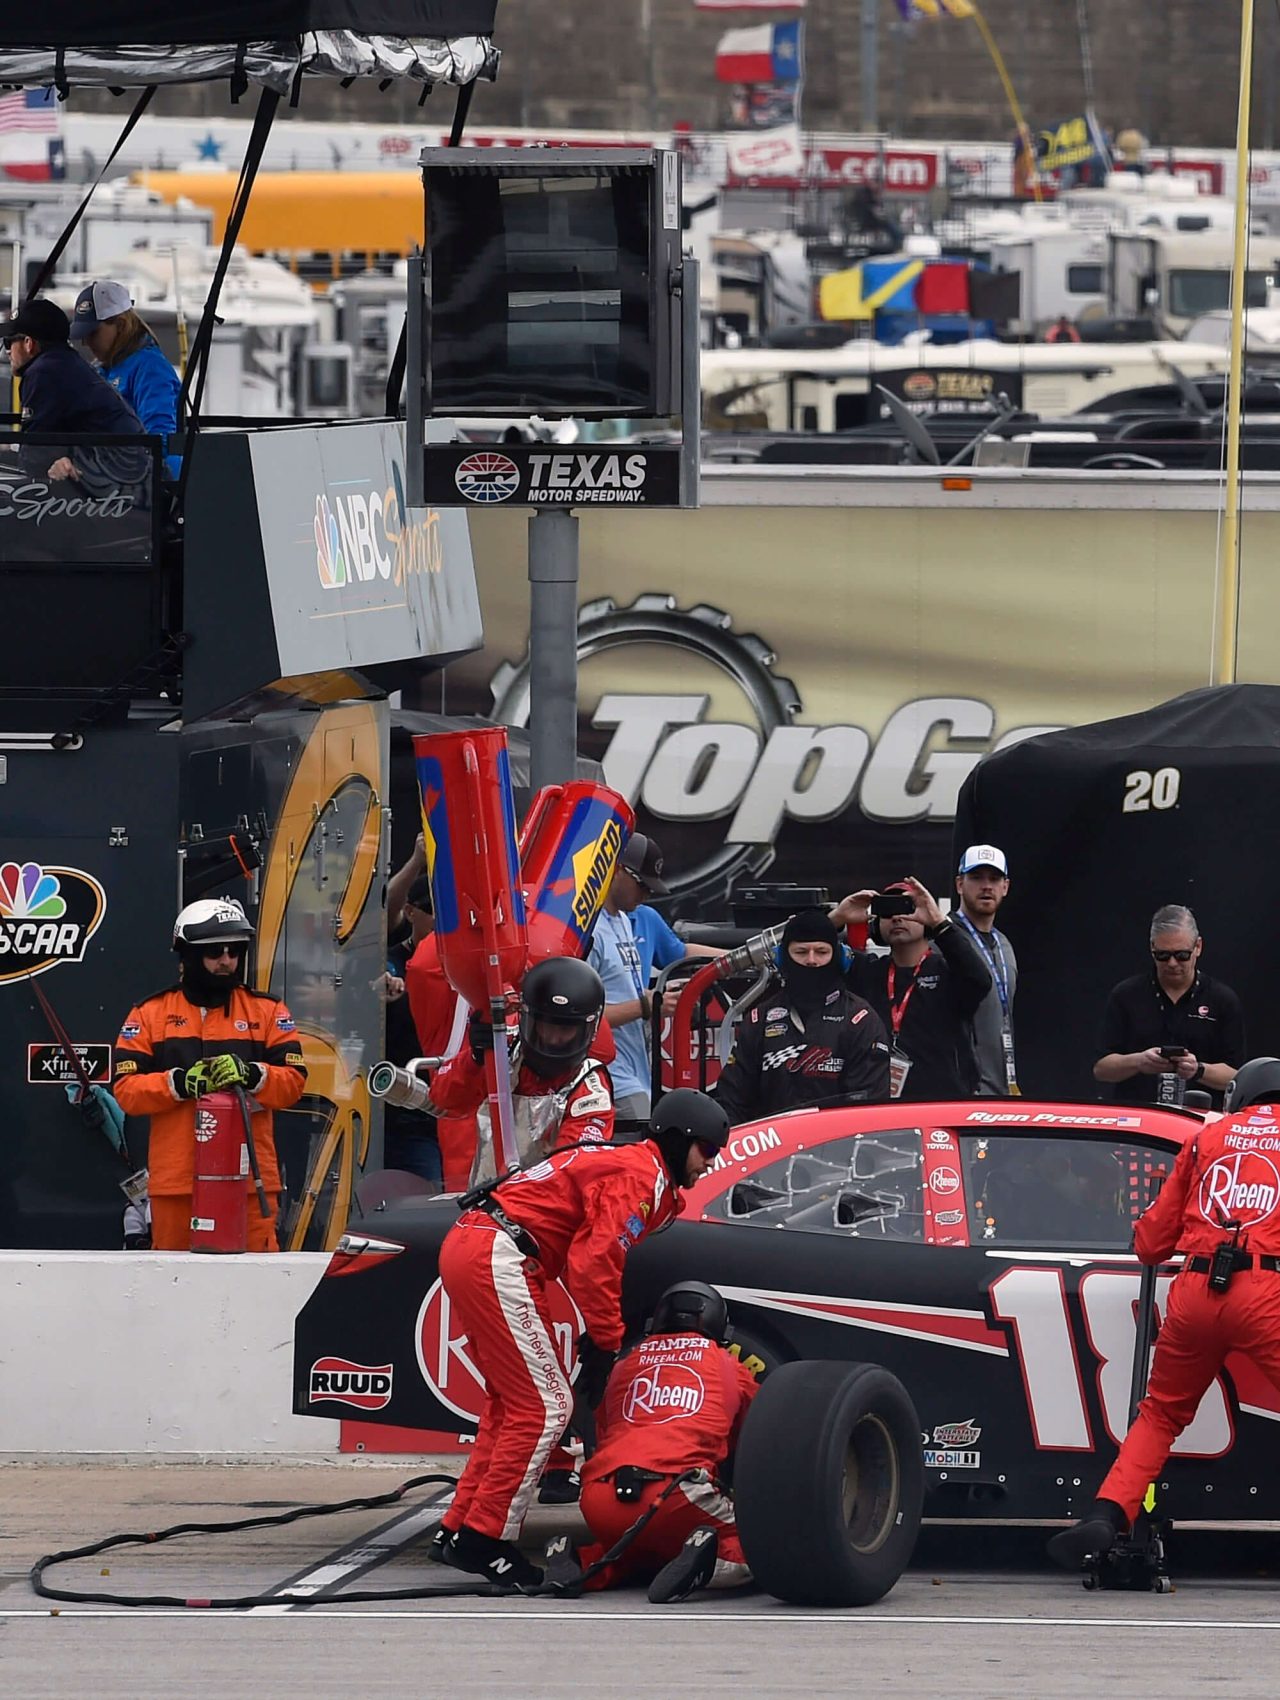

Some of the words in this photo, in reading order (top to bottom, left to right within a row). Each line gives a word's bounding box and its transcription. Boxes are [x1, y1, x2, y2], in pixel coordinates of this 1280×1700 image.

[528, 455, 647, 488] TEXAS
[12, 483, 135, 527] Sports
[528, 489, 573, 502] MOTOR
[575, 489, 641, 502] SPEEDWAY
[335, 491, 392, 583] NBC
[592, 694, 1078, 846] TopG
[1123, 768, 1180, 812] 20
[576, 825, 621, 929] SUNOCO
[42, 1056, 98, 1075] xfinty
[1162, 1073, 1176, 1101] 2018
[966, 1112, 1027, 1123] Ryan
[1032, 1114, 1116, 1125] Preece
[926, 1143, 955, 1151] TOYOTA
[1205, 1154, 1276, 1219] Rheem
[515, 1303, 533, 1330] The
[527, 1331, 547, 1360] new
[542, 1363, 568, 1410] degree
[639, 1338, 710, 1353] STAMPER
[639, 1351, 703, 1365] RHEEM.COM
[311, 1372, 391, 1395] RUUD
[628, 1365, 699, 1418] Rheem
[924, 1452, 961, 1463] Mobil
